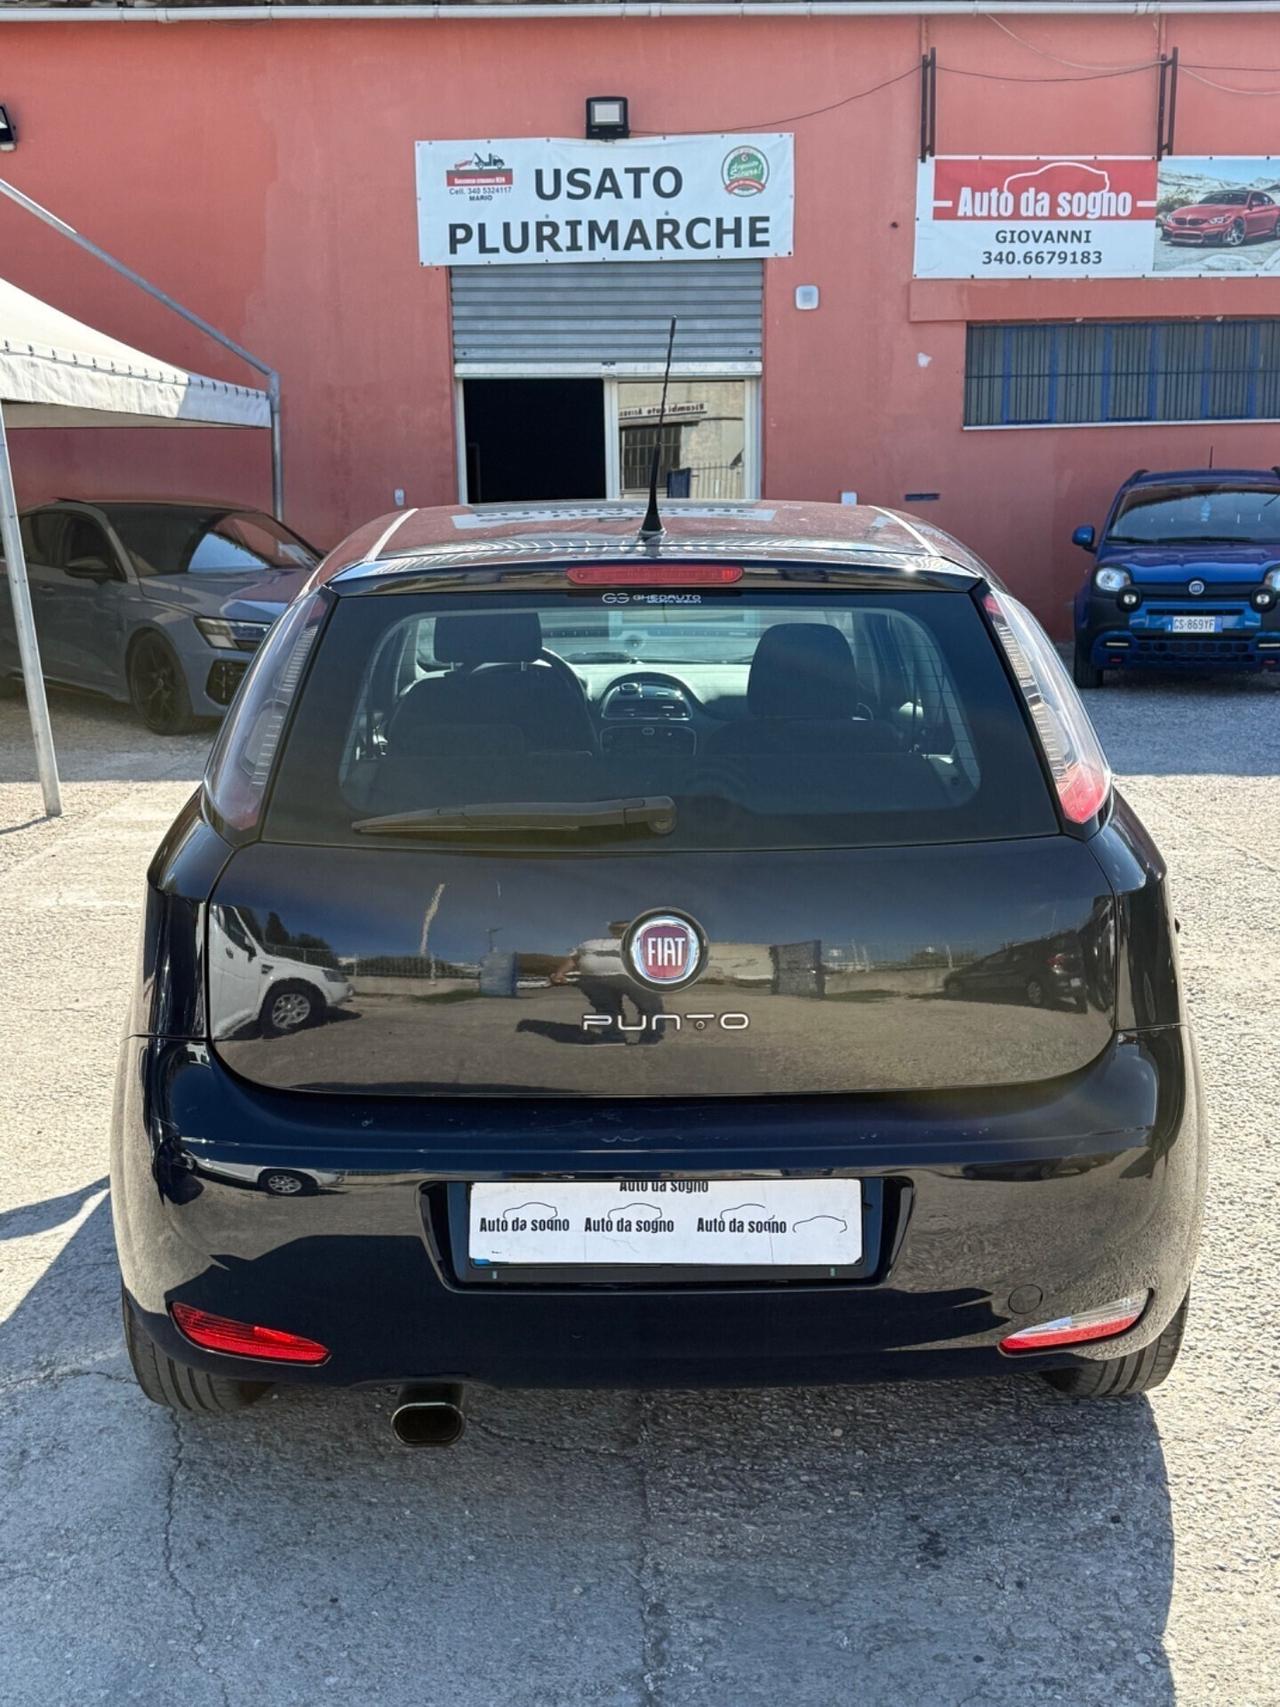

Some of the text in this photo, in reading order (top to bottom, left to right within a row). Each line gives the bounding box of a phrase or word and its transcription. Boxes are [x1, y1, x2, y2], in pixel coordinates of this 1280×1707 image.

[535, 166, 683, 200] USATO
[957, 186, 1132, 219] Auto da sogno
[448, 216, 771, 255] PLURIMARCHE
[995, 230, 1092, 244] GIOVANNI
[982, 250, 1103, 265] 340.6679183
[647, 937, 685, 966] FIAT
[583, 1013, 749, 1031] PUNTO
[619, 1181, 648, 1192] Auto
[670, 1181, 709, 1194] sogno
[479, 1217, 570, 1232] Auto da sogno
[584, 1217, 674, 1233] Auto da sogno
[697, 1217, 787, 1233] Auto da sogno
